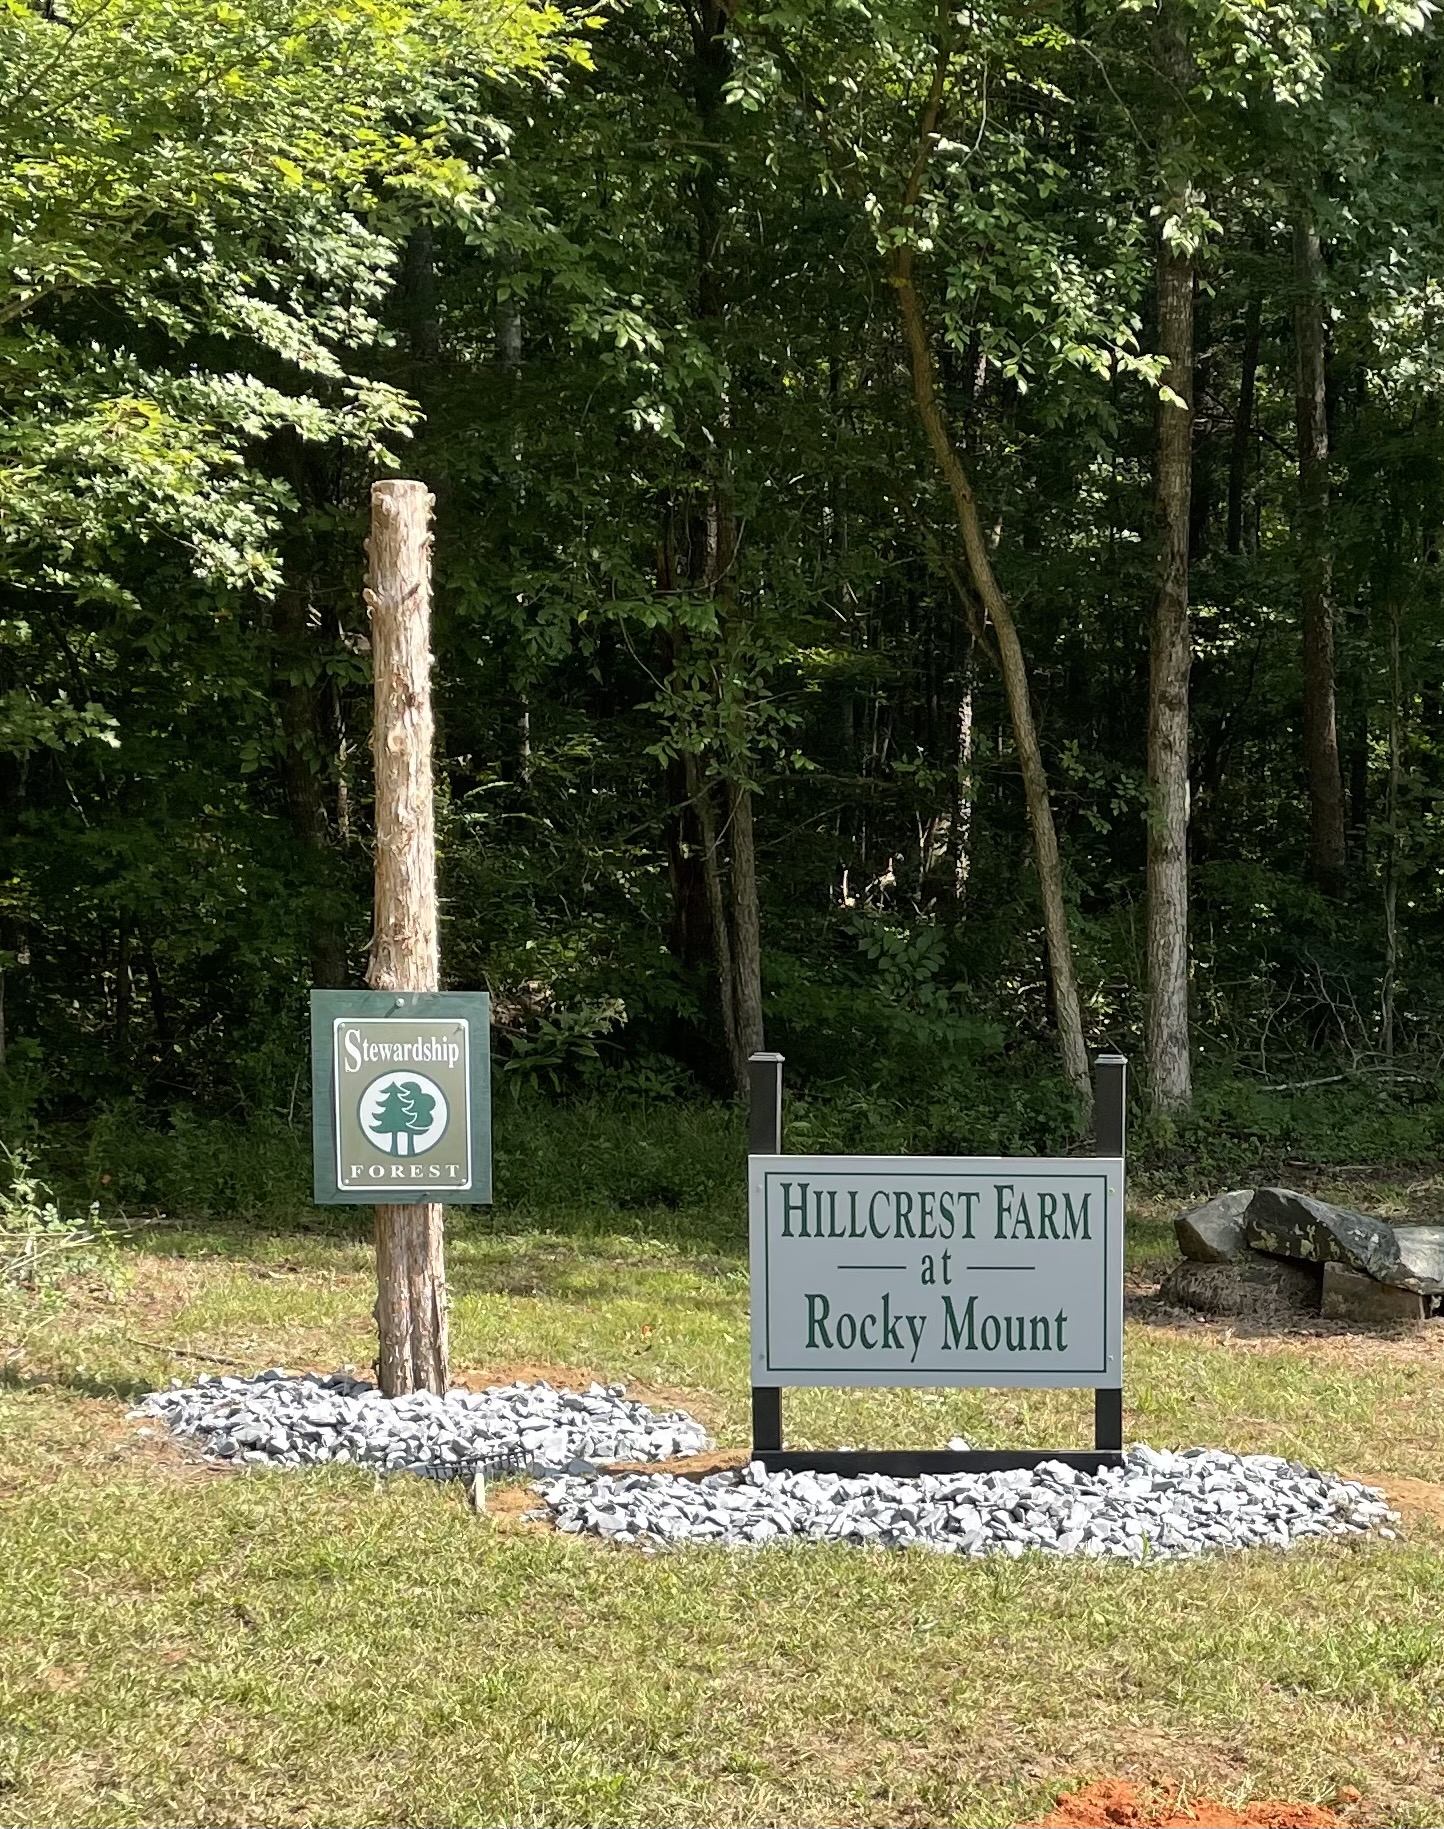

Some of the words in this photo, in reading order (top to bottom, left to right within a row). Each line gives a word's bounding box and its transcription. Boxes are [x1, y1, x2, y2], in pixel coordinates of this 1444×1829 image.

[344, 1028, 460, 1073] Stewardship
[350, 1164, 460, 1179] FOREST
[779, 1182, 981, 1240] HILLCREST
[993, 1184, 1092, 1241] FARM
[920, 1247, 953, 1286] at
[804, 1292, 927, 1363] Rocky
[940, 1295, 1069, 1352] Mount
